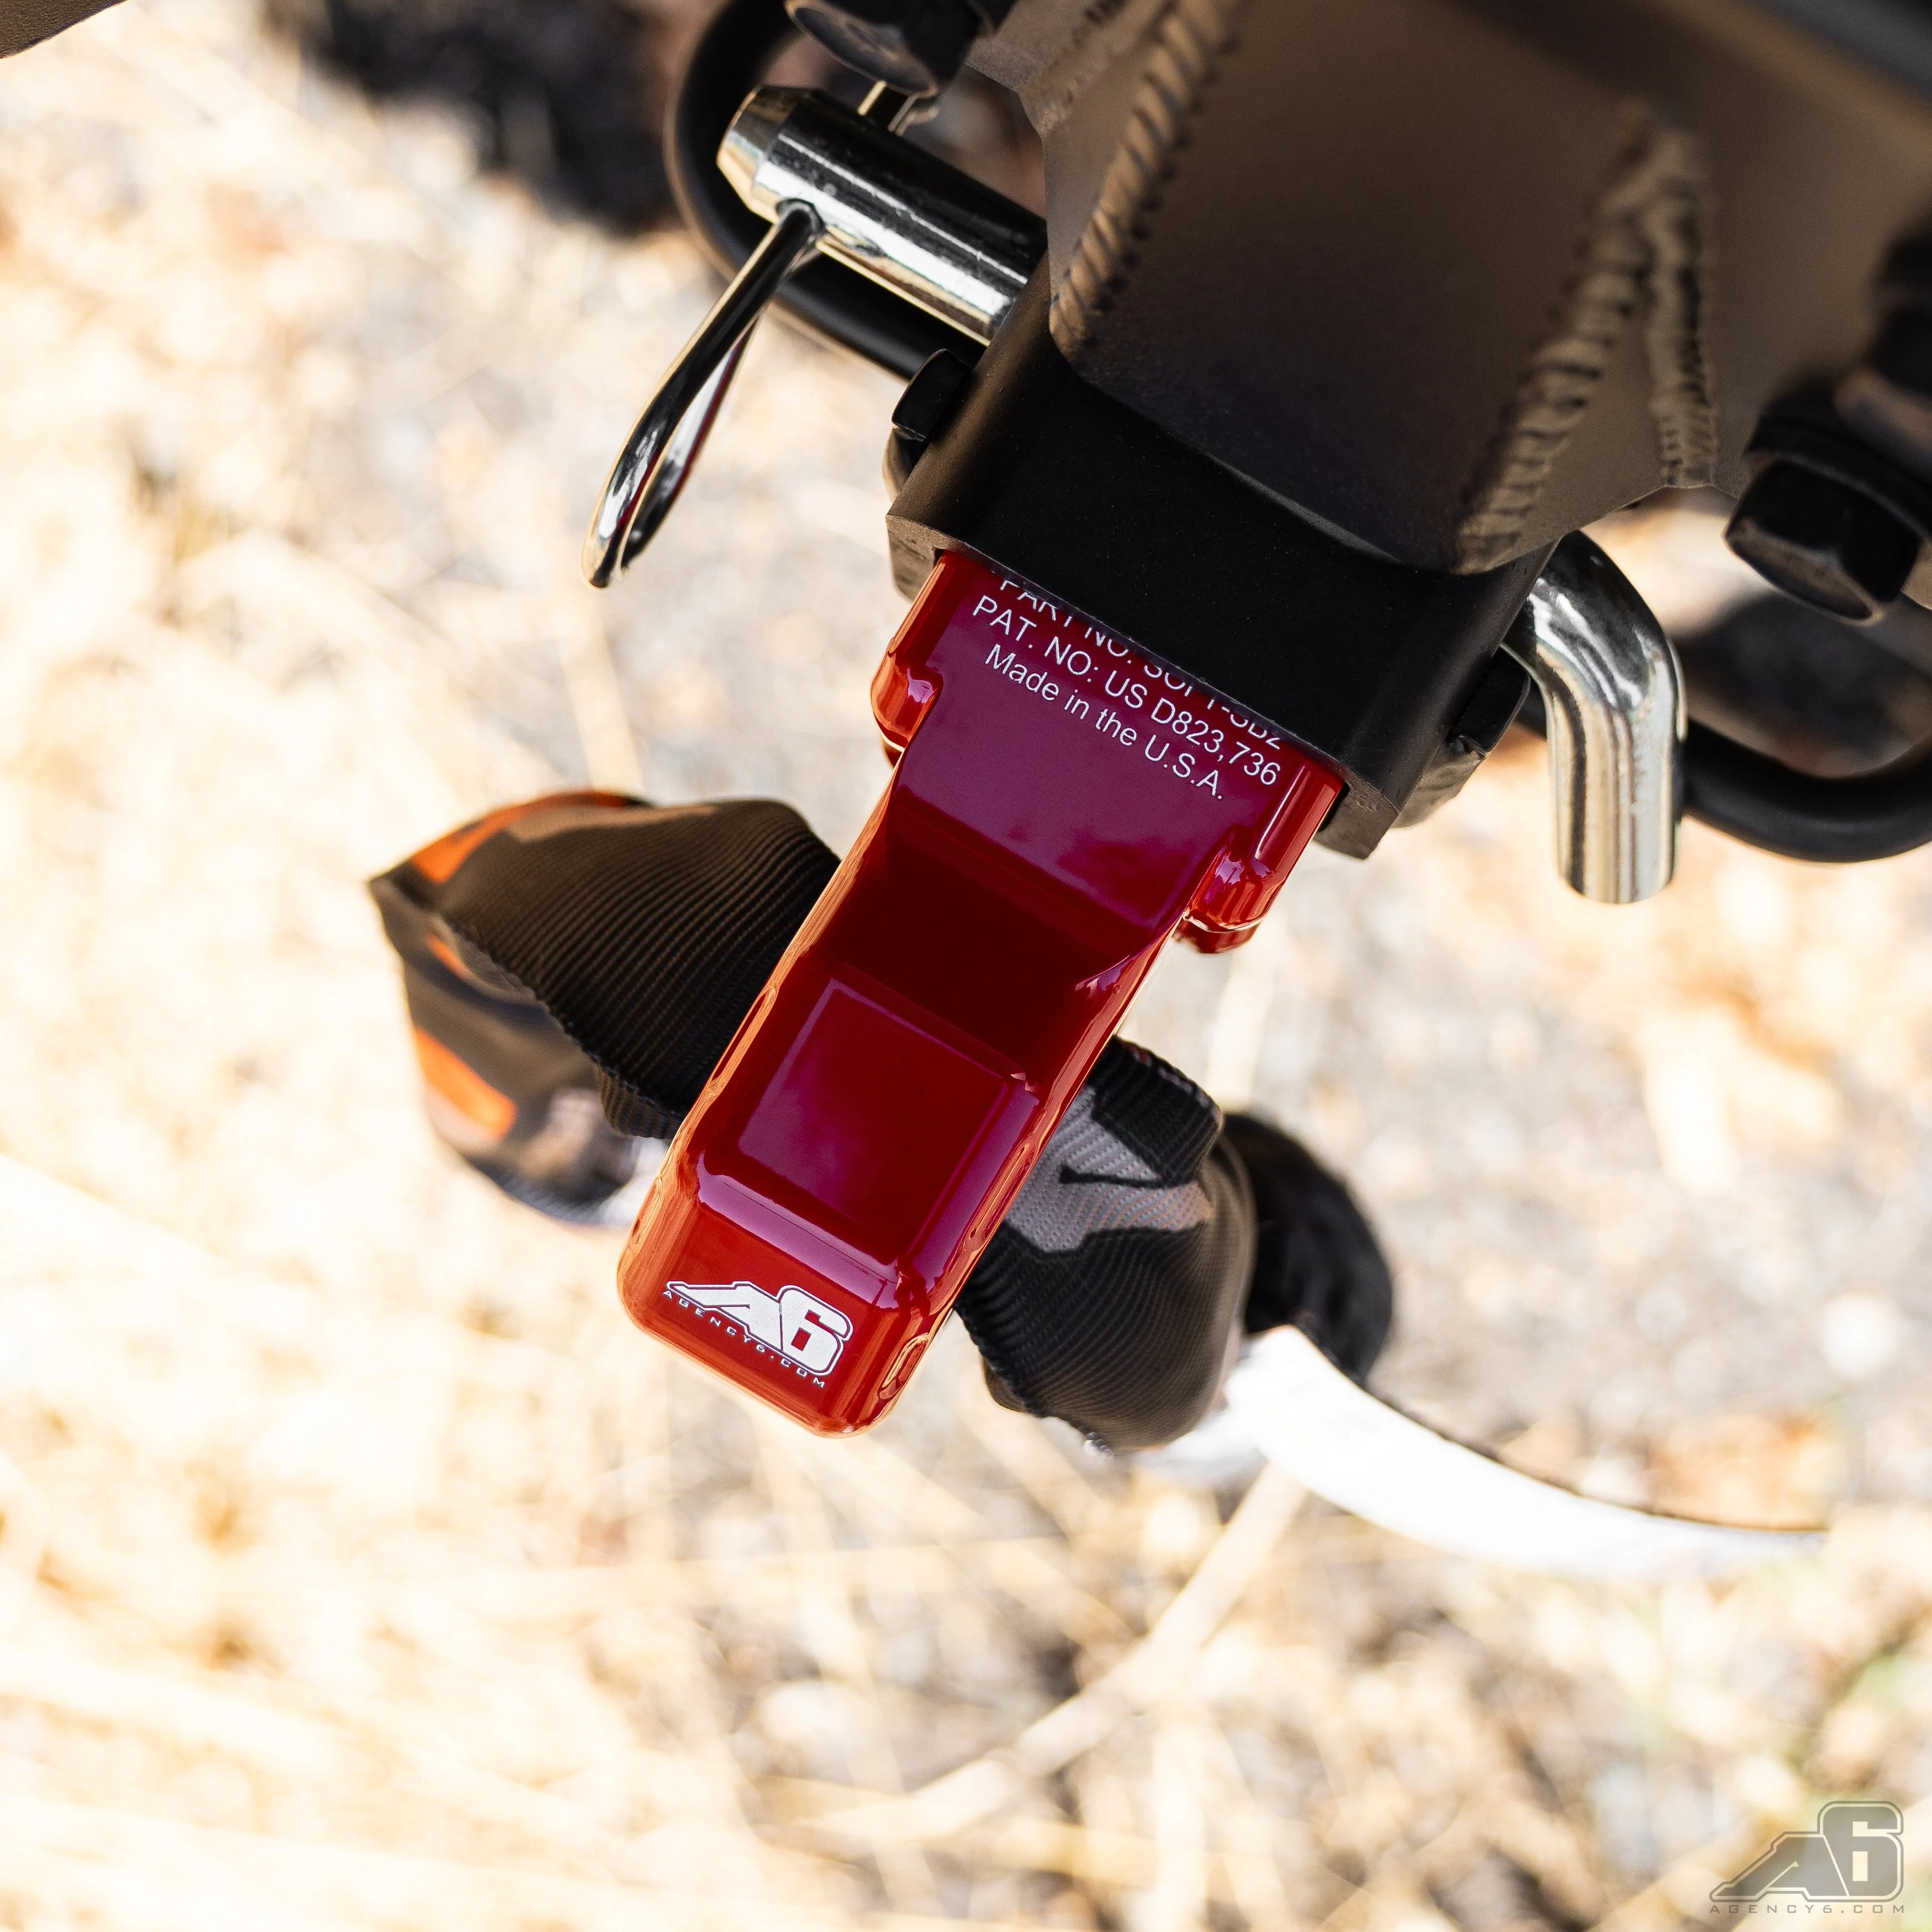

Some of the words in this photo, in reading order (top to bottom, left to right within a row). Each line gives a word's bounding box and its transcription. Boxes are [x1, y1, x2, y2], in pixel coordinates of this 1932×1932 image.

[972, 595, 1037, 649] PAT.
[1044, 635, 1099, 683] NO:
[1105, 670, 1148, 708] US
[1151, 697, 1281, 785] D823,736
[985, 643, 1059, 701] Made
[1064, 688, 1090, 720] in
[1095, 708, 1137, 746] the
[1144, 734, 1222, 799] U.S.A.
